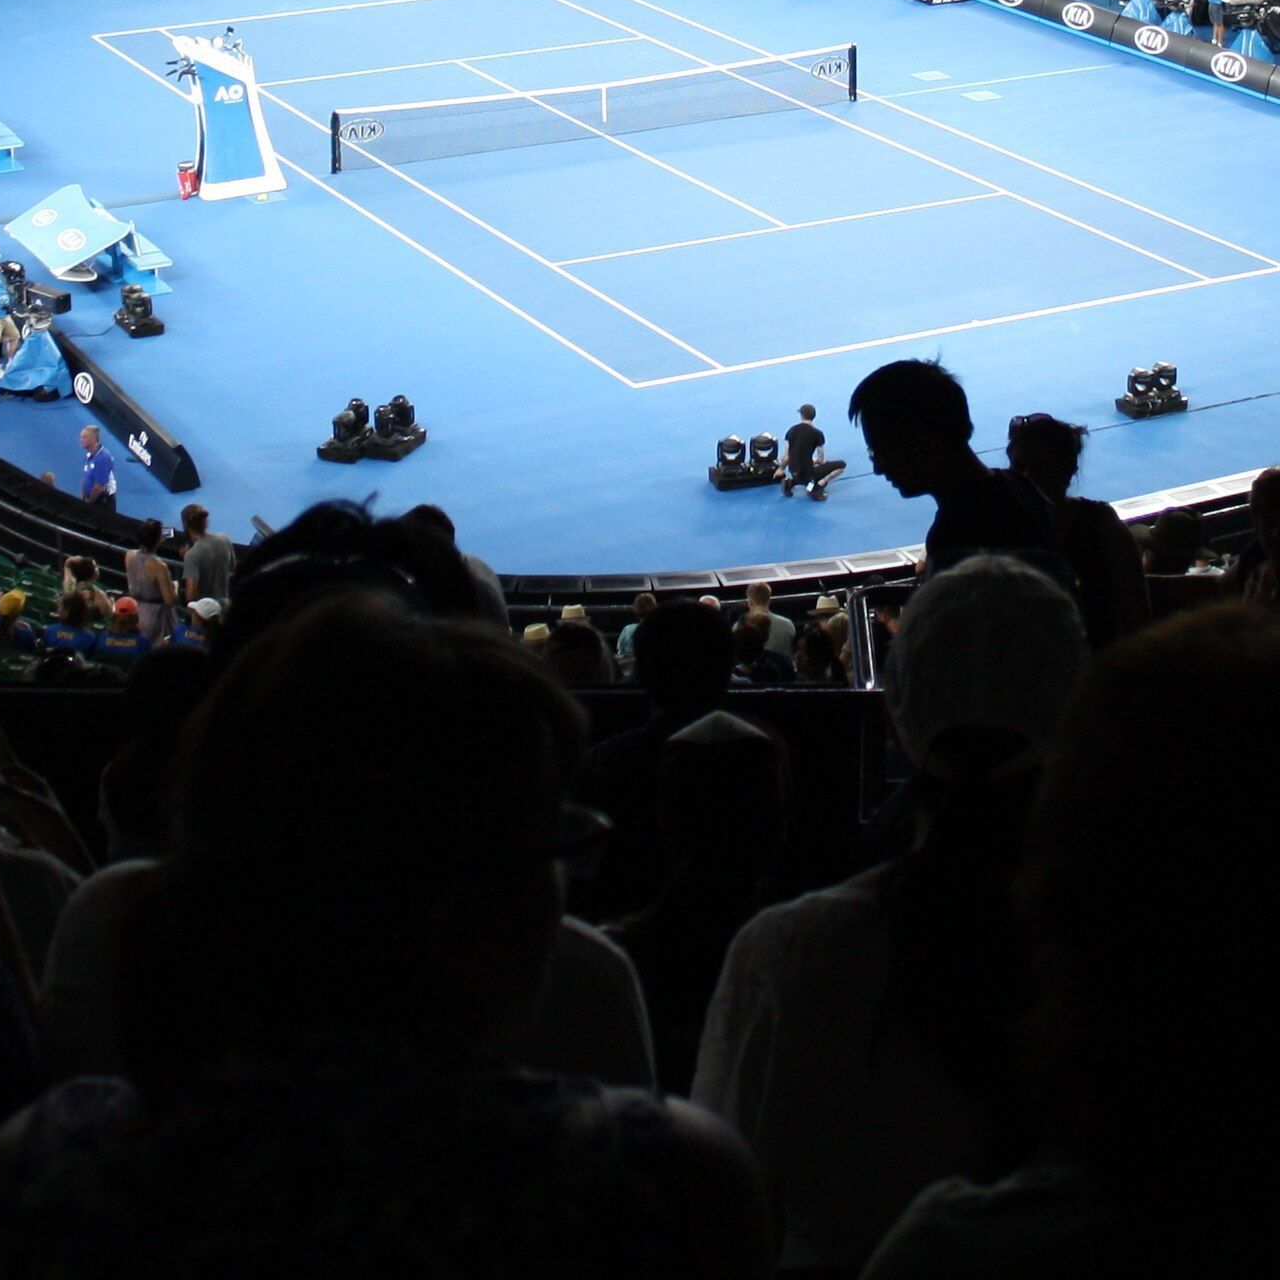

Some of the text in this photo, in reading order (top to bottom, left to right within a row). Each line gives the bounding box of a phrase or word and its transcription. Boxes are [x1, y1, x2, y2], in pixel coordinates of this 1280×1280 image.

[1066, 6, 1089, 26] KIA
[1139, 30, 1163, 50] KIA
[1216, 56, 1241, 78] KIA
[214, 84, 244, 102] AO
